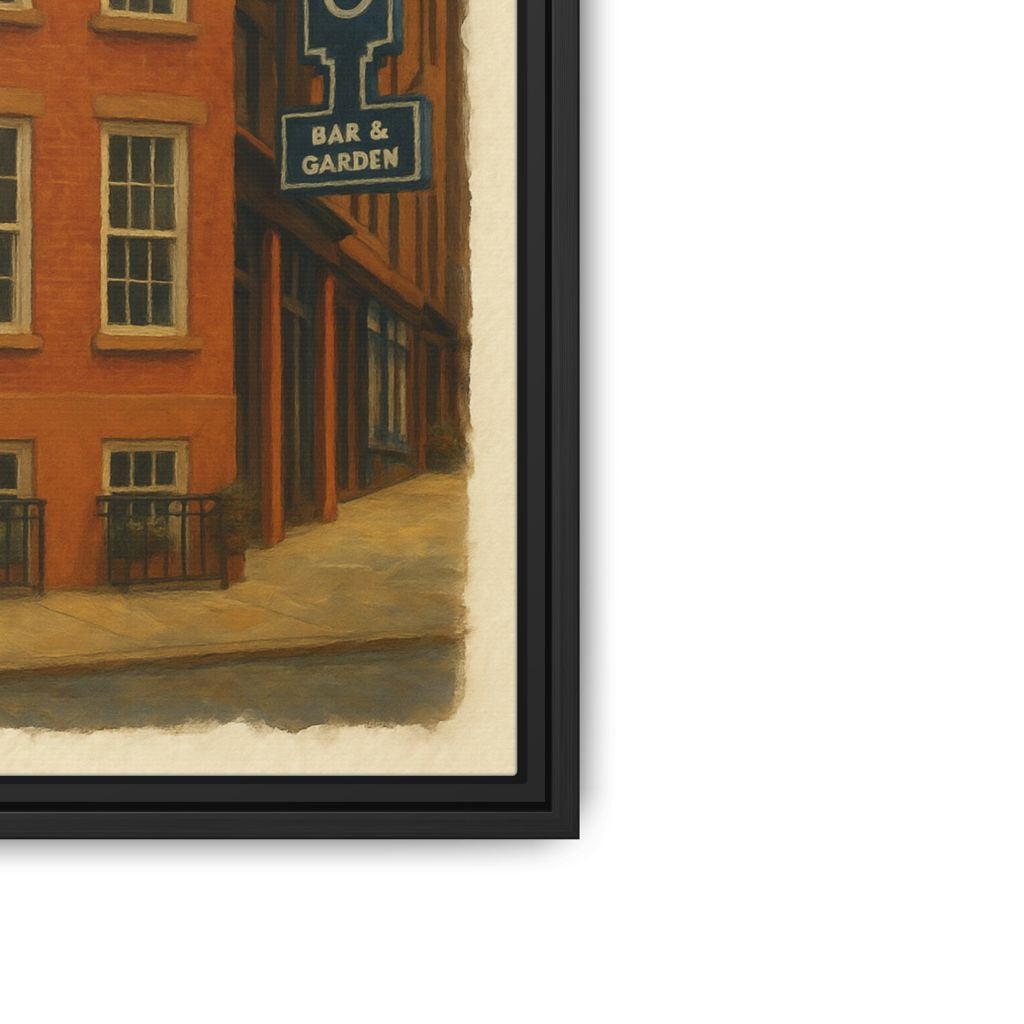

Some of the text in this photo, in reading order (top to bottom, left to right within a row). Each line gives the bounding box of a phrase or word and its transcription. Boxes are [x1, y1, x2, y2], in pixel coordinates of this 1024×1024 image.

[311, 120, 389, 146] BAR &
[301, 146, 399, 175] GARDEN
